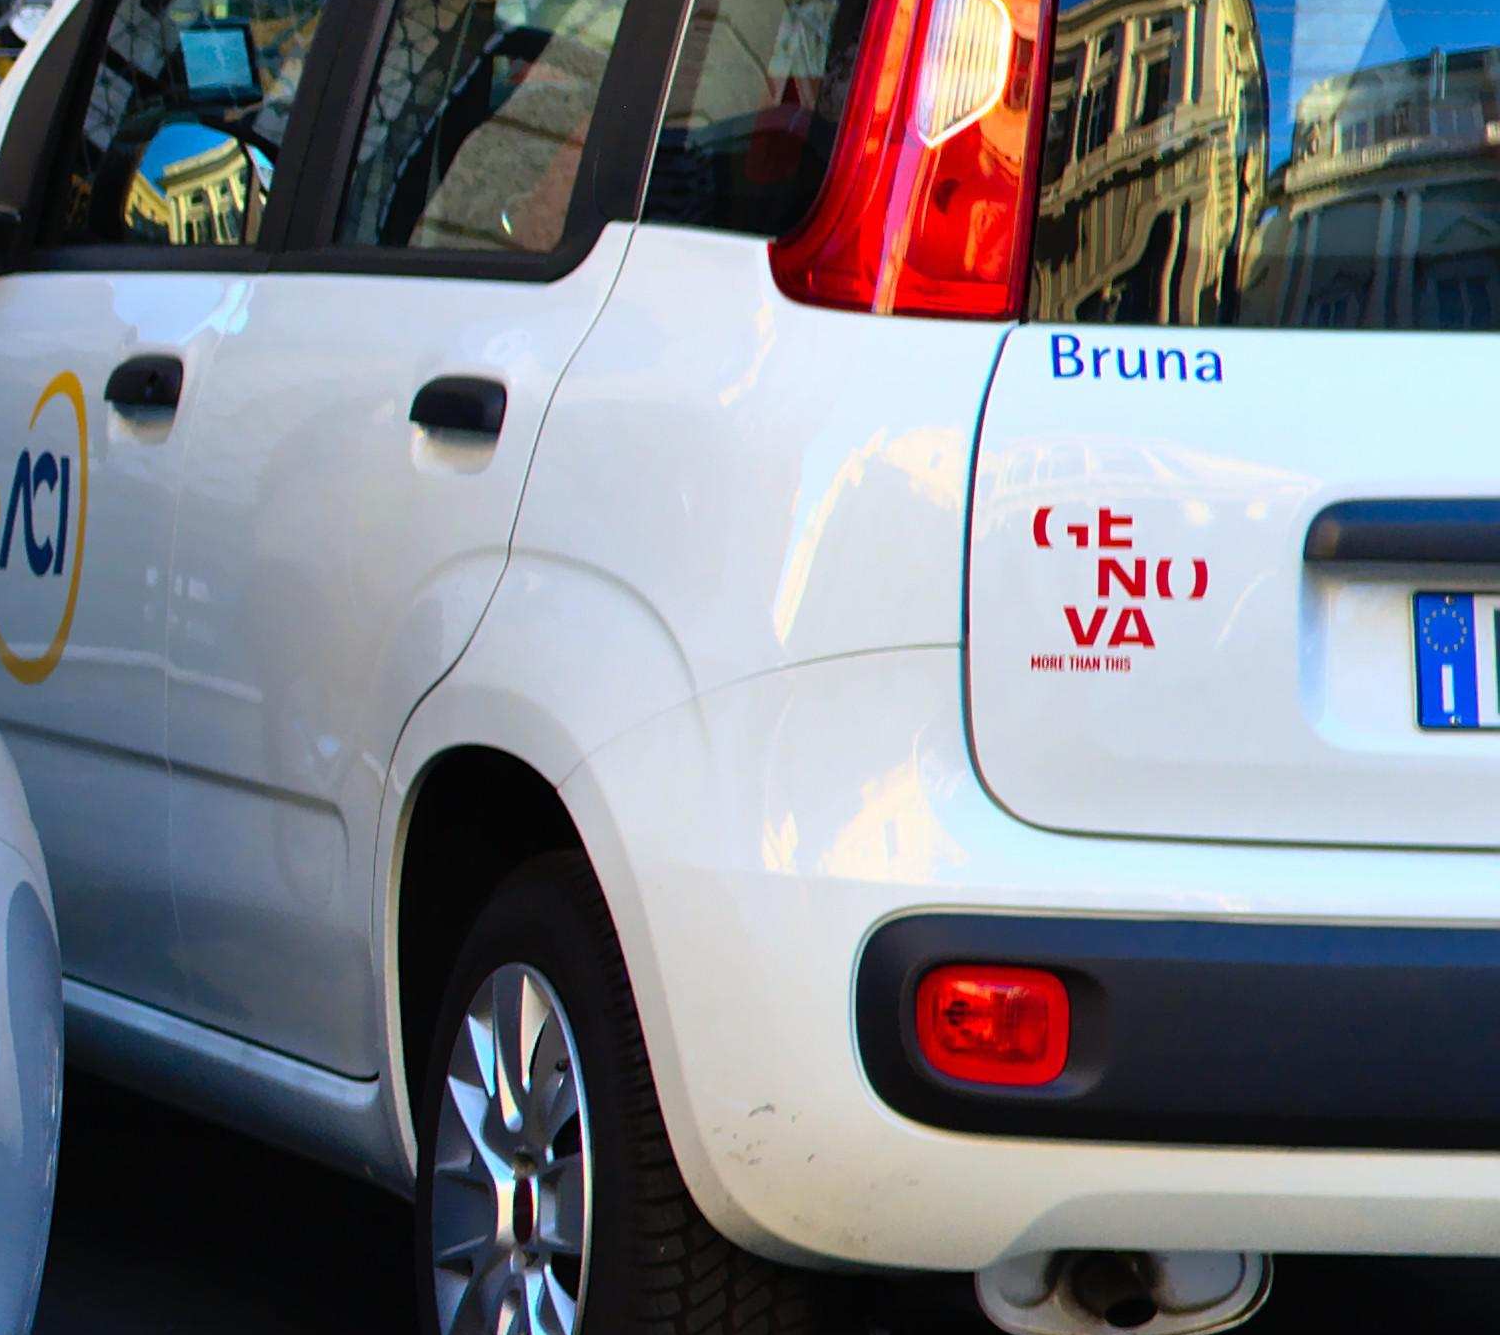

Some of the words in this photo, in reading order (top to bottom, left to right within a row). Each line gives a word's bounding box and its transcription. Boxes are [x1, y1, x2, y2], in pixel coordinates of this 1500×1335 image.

[1050, 333, 1225, 383] Bruna
[1031, 654, 1065, 672] MORE
[1069, 655, 1101, 672] THAN
[1104, 655, 1132, 673] THIS
